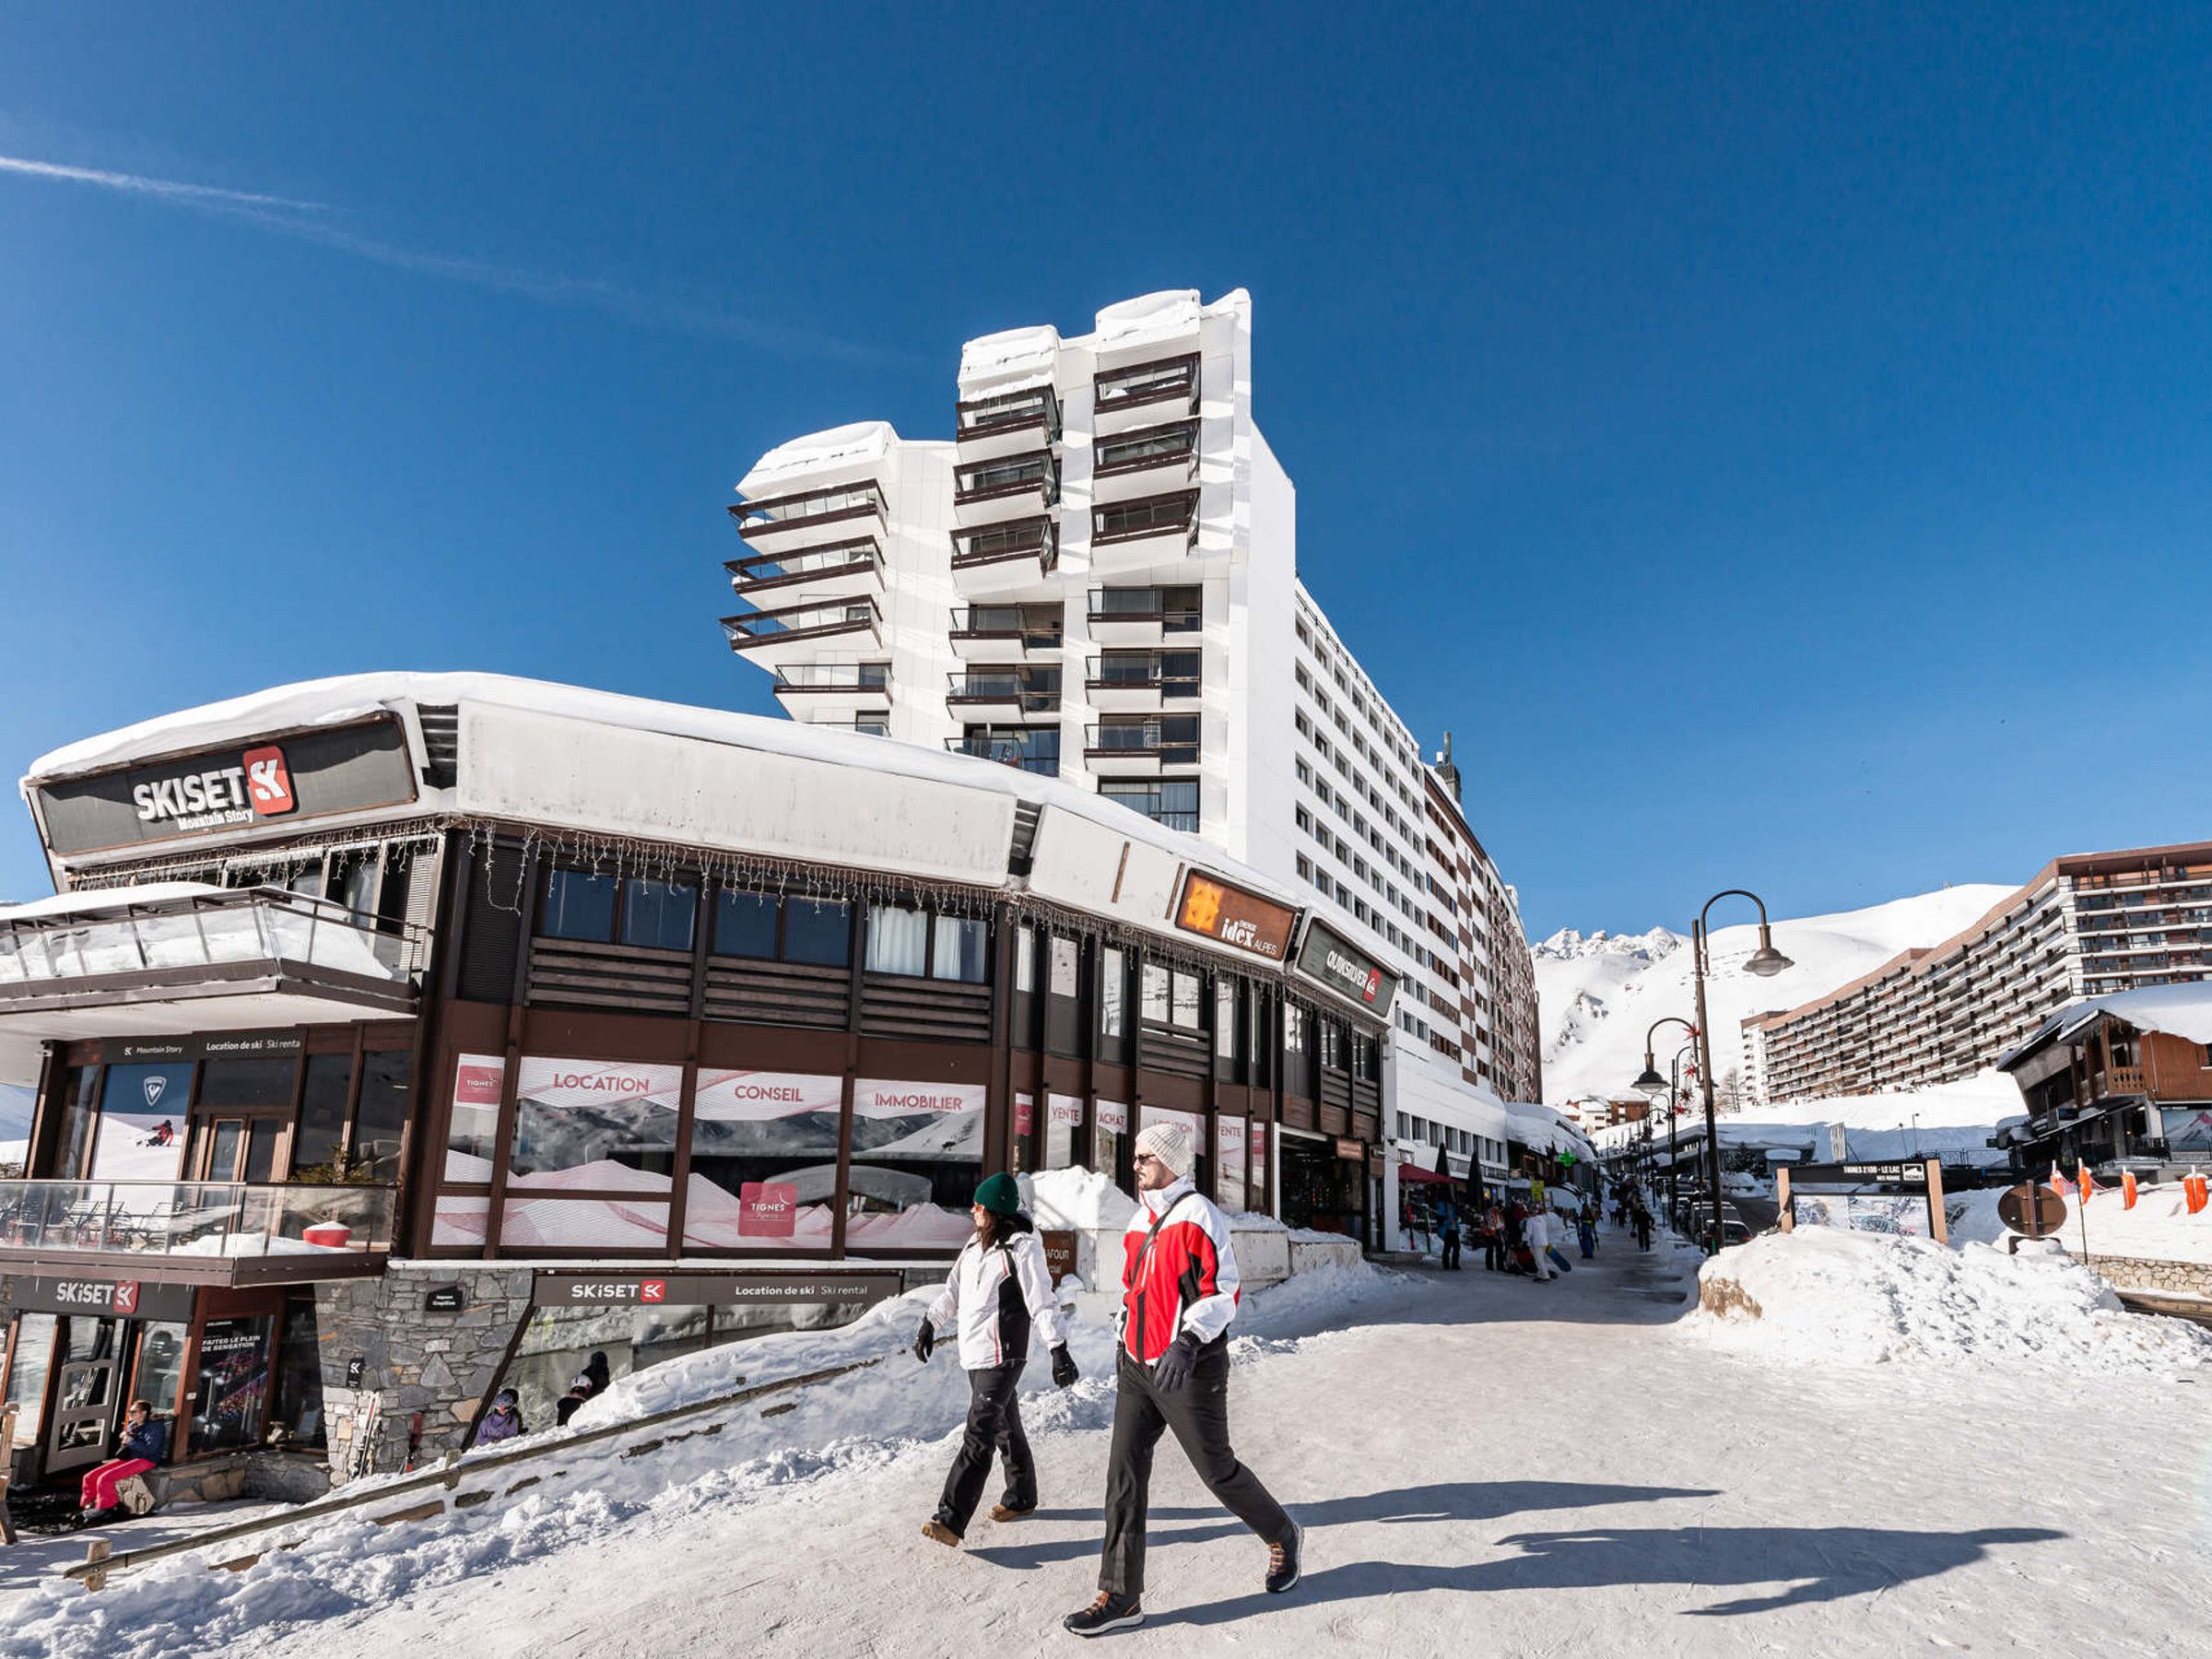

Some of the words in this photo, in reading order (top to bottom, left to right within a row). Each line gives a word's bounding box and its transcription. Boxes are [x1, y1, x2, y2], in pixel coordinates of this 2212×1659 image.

[177, 813, 226, 830] Mountain
[226, 808, 254, 823] Story
[1326, 950, 1369, 989] QUIKSILVER
[165, 1045, 183, 1054] Story
[206, 1041, 240, 1051] Location
[240, 1041, 250, 1050] de
[251, 1040, 263, 1049] ski
[266, 1039, 278, 1049] Ski
[553, 1073, 650, 1094] LOCATION
[735, 1085, 804, 1102] CONSEIL
[875, 1092, 963, 1112] IMMOBILIER
[1053, 1107, 1079, 1123] VENTE
[1099, 1113, 1124, 1126] ACHAT
[1219, 1125, 1242, 1137] ENTE
[751, 1203, 786, 1212] TIGNES
[735, 1285, 782, 1296] Location
[783, 1285, 798, 1296] de
[799, 1285, 815, 1296] ski
[820, 1285, 836, 1296] Ski
[838, 1285, 868, 1296] rental
